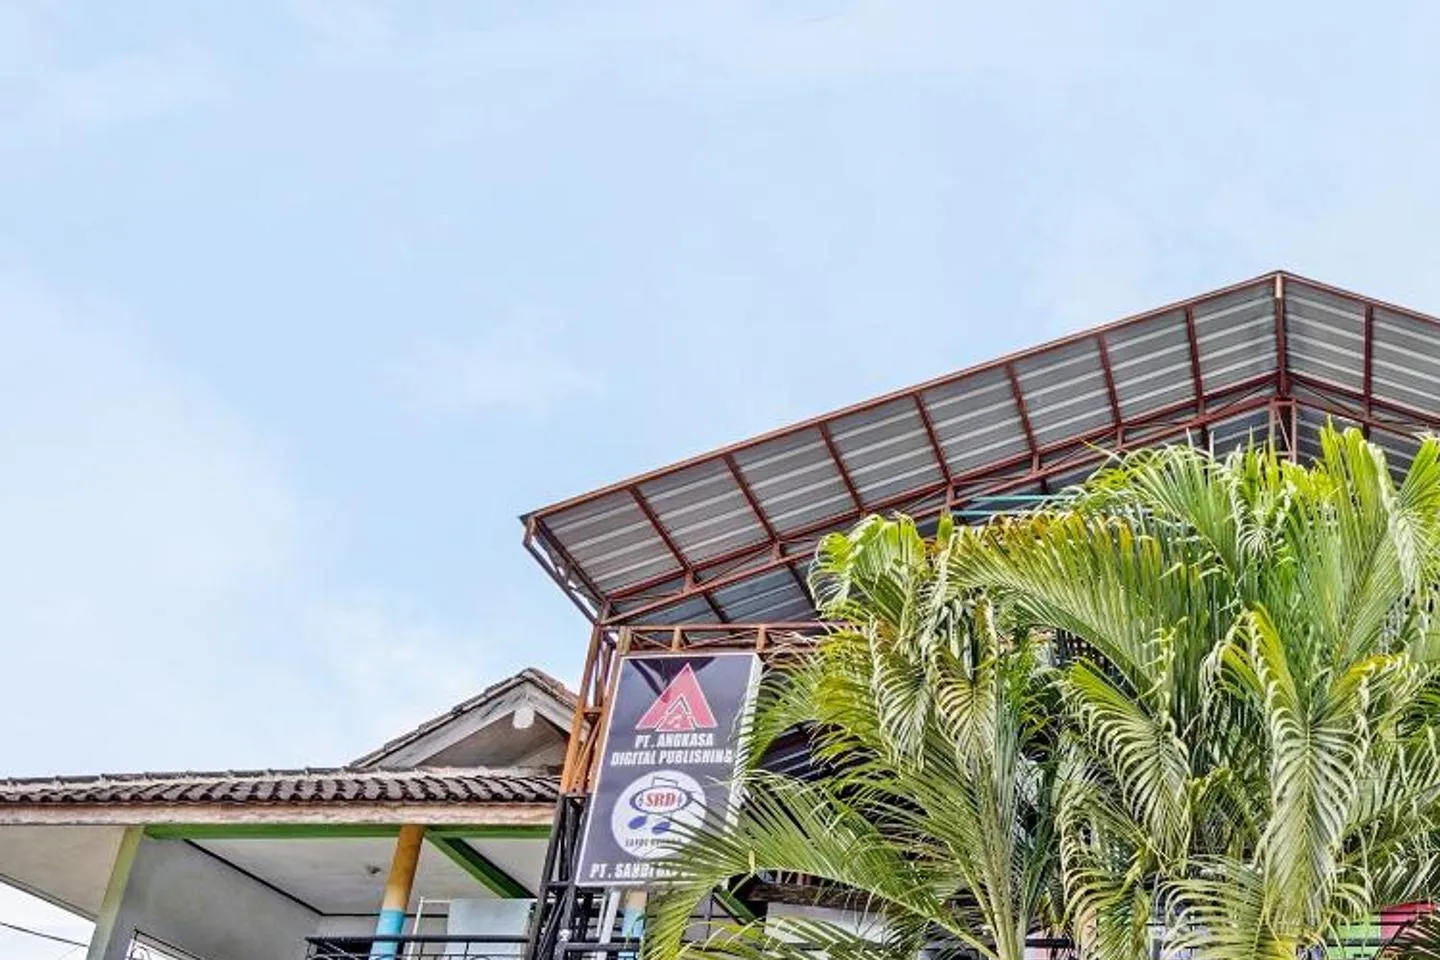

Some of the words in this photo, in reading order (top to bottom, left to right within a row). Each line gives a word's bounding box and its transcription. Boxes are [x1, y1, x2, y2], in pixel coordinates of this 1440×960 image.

[634, 734, 655, 748] PT.
[656, 732, 714, 748] ANGKASA
[610, 750, 657, 766] DIGITAL
[658, 748, 734, 765] PUBLISHING
[589, 862, 612, 878] PT.
